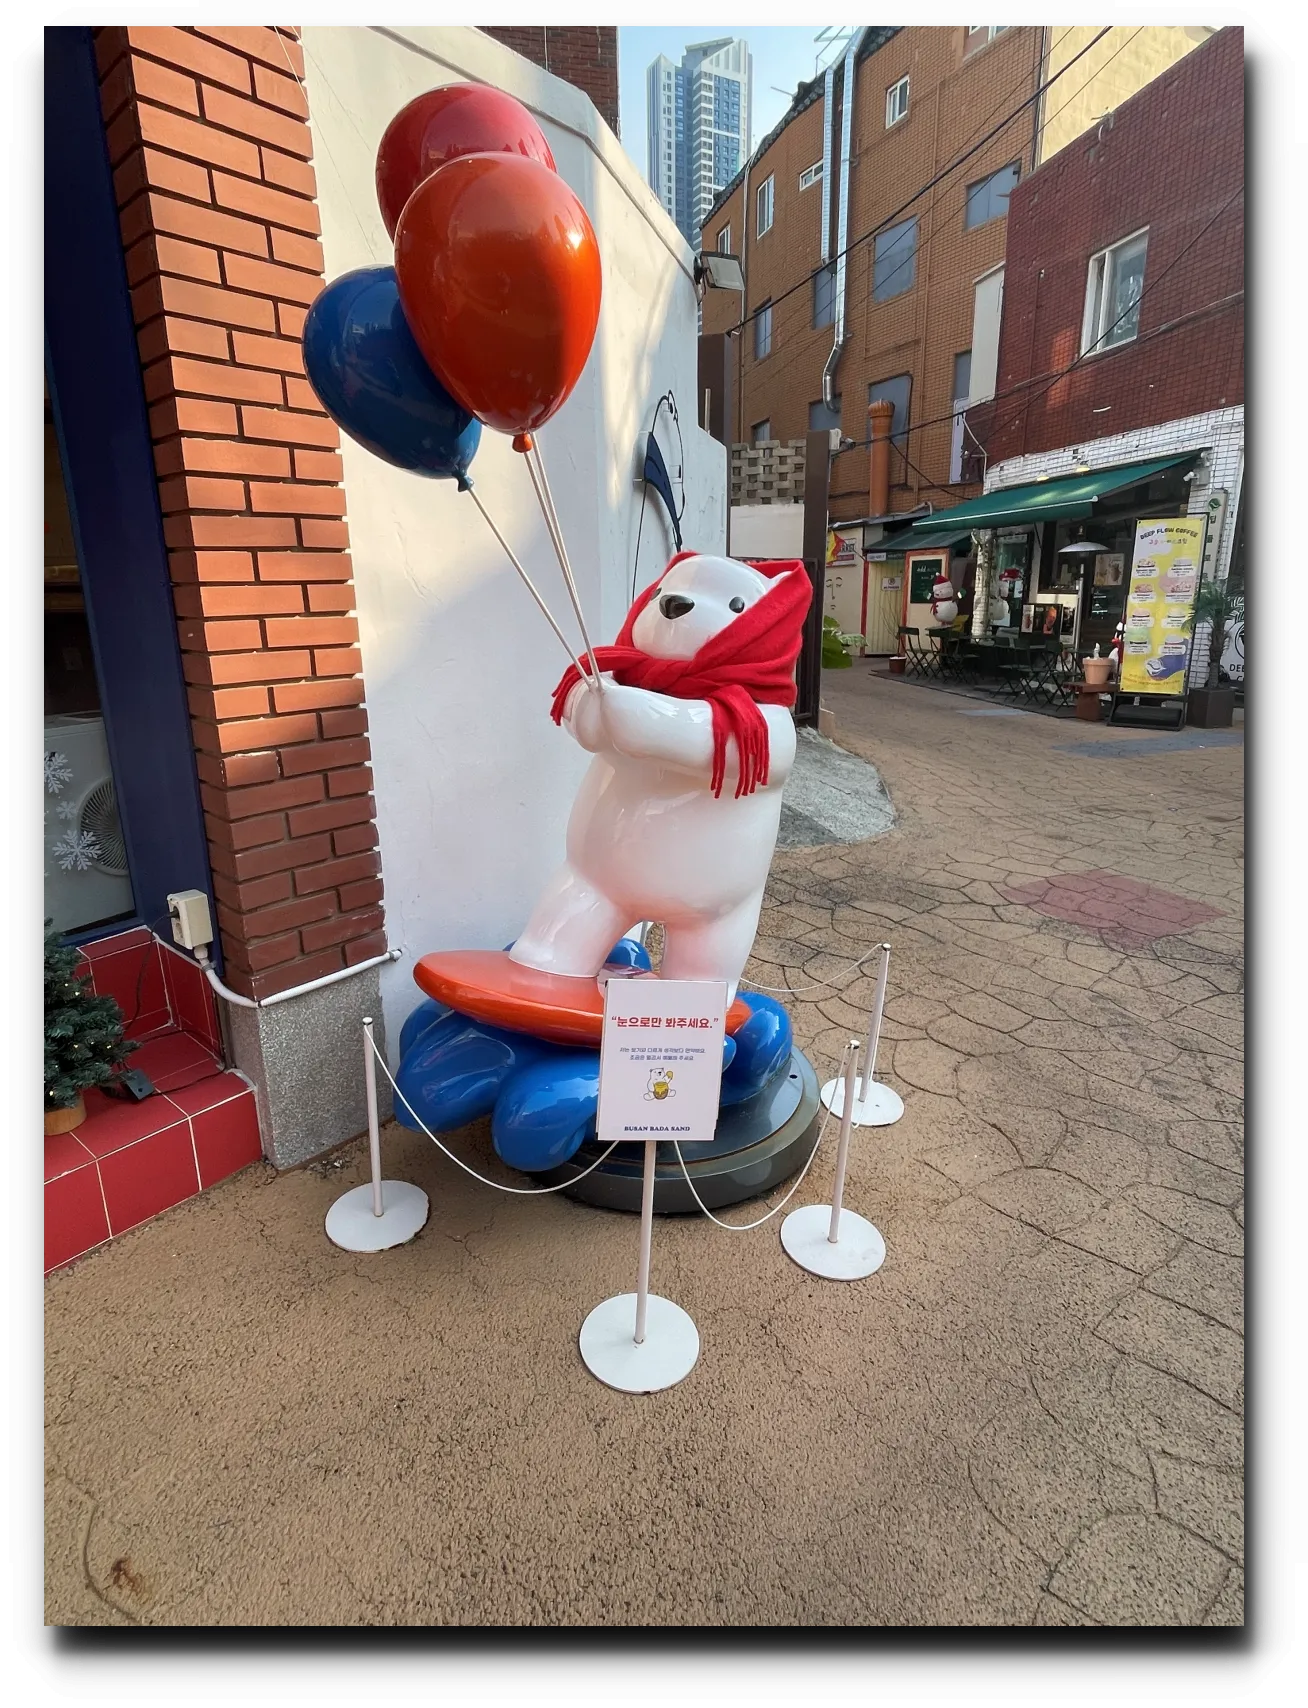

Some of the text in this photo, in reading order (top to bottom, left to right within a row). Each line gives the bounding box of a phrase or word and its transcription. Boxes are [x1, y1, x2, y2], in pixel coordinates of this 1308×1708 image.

[1140, 530, 1155, 540] DEEP
[1175, 527, 1199, 538] COFFEE
[611, 1016, 662, 1028] “눈으로만
